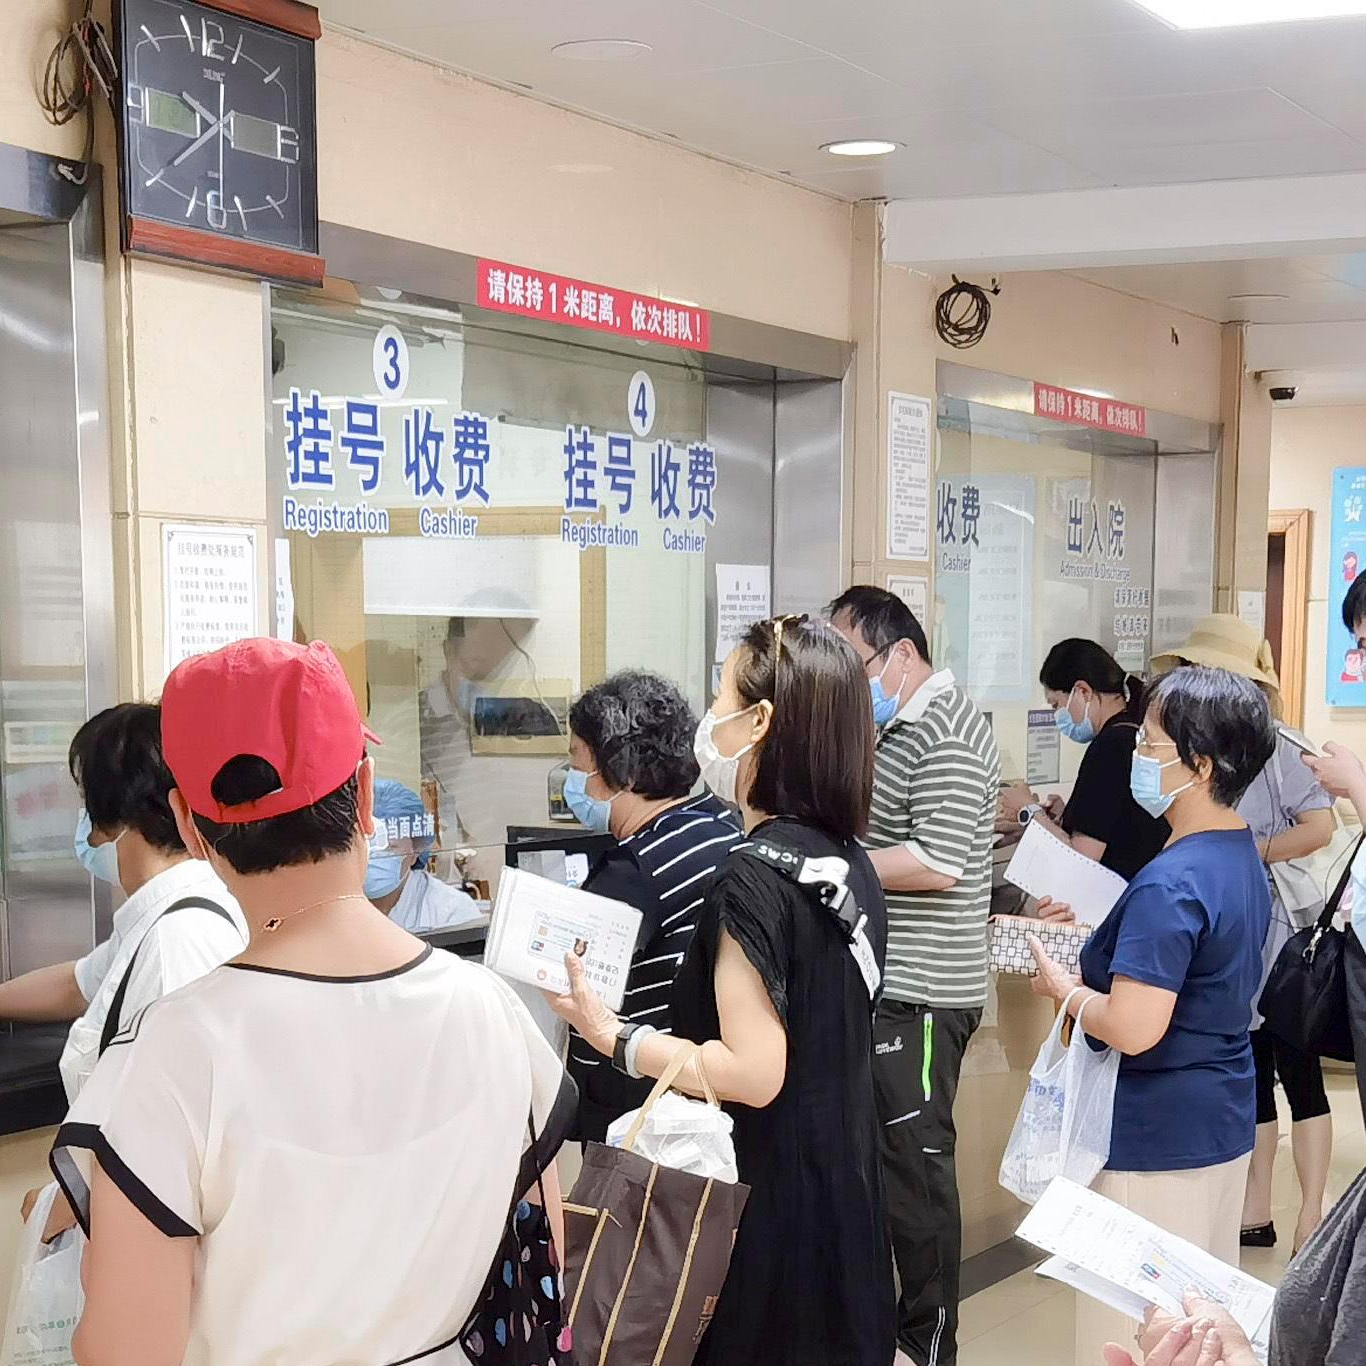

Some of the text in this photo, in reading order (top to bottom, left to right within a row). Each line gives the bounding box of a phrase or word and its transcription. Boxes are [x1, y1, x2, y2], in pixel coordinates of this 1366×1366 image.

[201, 17, 225, 62] 12
[206, 190, 227, 229] 6
[383, 337, 401, 389] 3
[633, 382, 648, 428] 4
[285, 392, 491, 503] 挂号 收费
[563, 428, 716, 523] 挂号 收费
[285, 500, 477, 538] Registration Cashier
[561, 519, 706, 553] Registration Cashier
[937, 482, 981, 547] 收费
[1067, 498, 1126, 560] 出入院
[942, 552, 972, 573] Cashier
